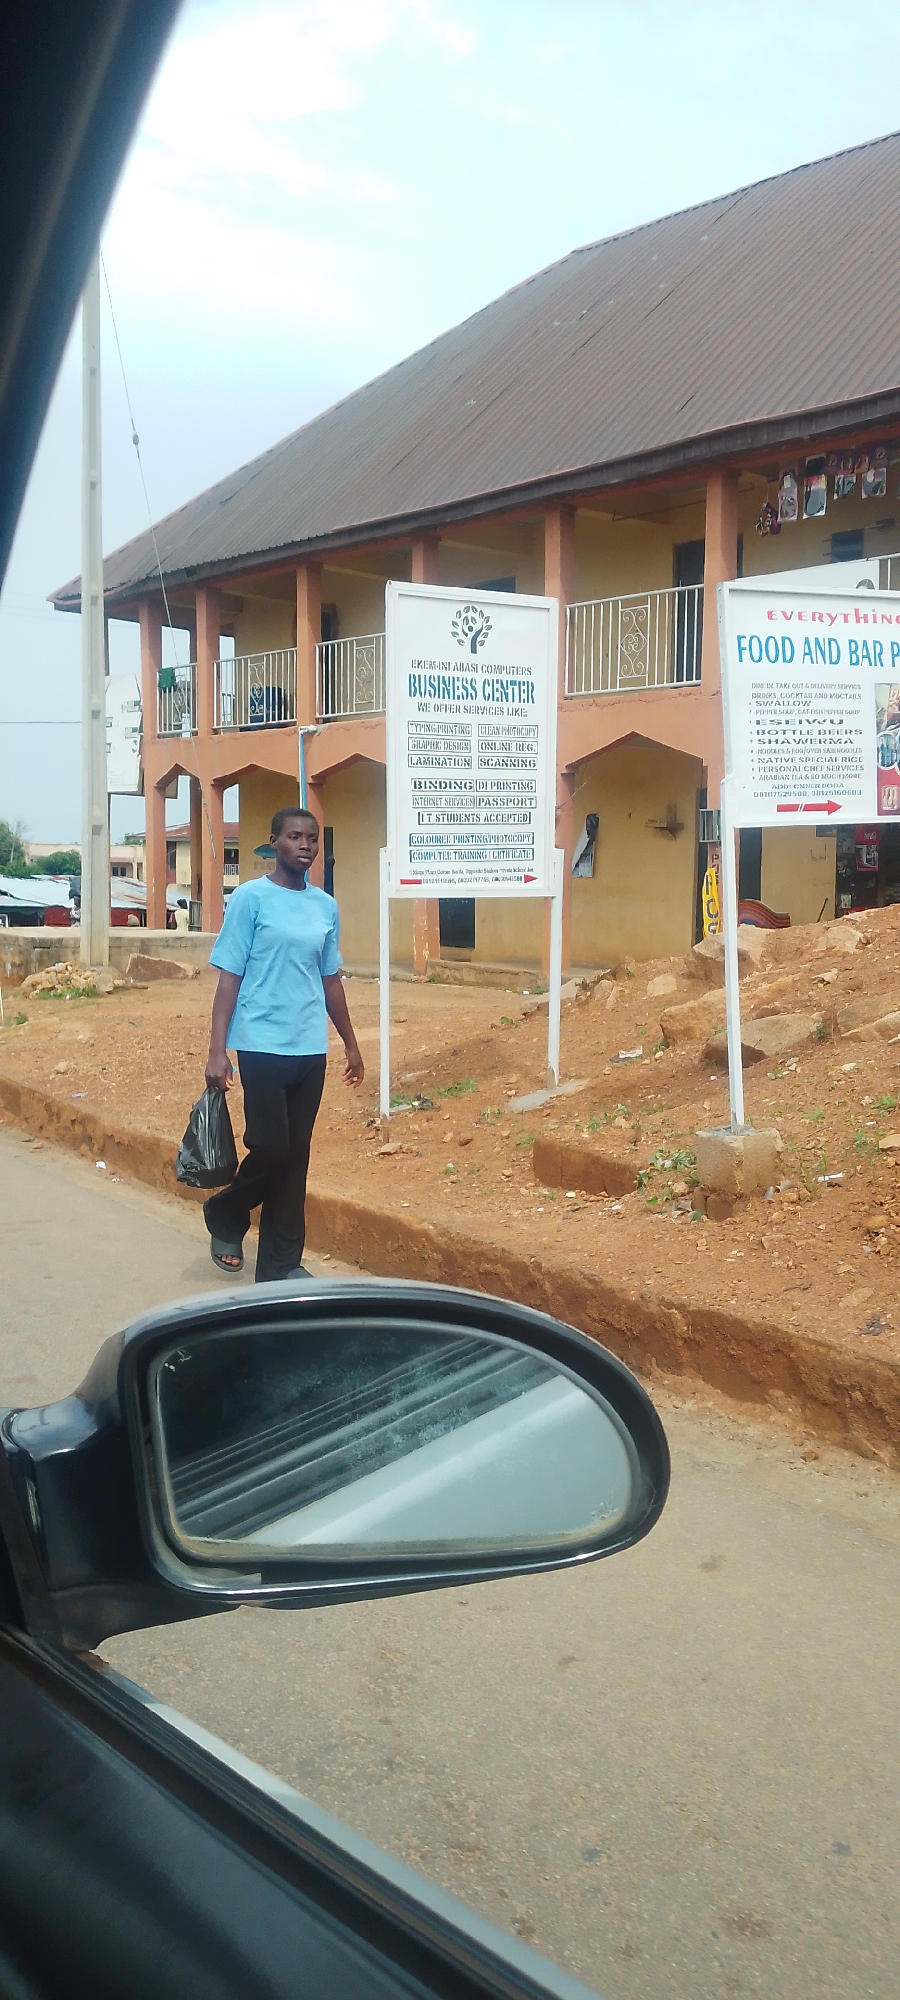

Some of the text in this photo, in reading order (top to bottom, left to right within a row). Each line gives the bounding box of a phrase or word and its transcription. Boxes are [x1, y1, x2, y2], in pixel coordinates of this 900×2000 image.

[737, 635, 795, 663] FOOD
[802, 637, 841, 665] AND
[848, 639, 884, 667] BAR
[453, 662, 478, 673] ABASI
[481, 664, 532, 675] COMPUTERS
[409, 673, 535, 704] BUSINESS CENTER
[417, 702, 430, 712] WE
[434, 703, 460, 714] OFFER
[463, 705, 504, 716] SERVICES
[481, 726, 536, 737] CLEAN PHOTOCOPY
[412, 739, 469, 751] GRAPHIC DESIGN
[481, 741, 513, 752] ONLINE
[410, 756, 471, 767] LAMINATION
[480, 758, 536, 768] SCANNING
[413, 780, 473, 790] BINDING
[490, 781, 533, 791] PRINTING
[412, 796, 474, 807] INTERNET SERVICES
[478, 797, 535, 807] PASSPORT
[436, 814, 481, 822] STUDENTS
[484, 813, 528, 822] ACCEPTED
[453, 850, 487, 860] TRAINING
